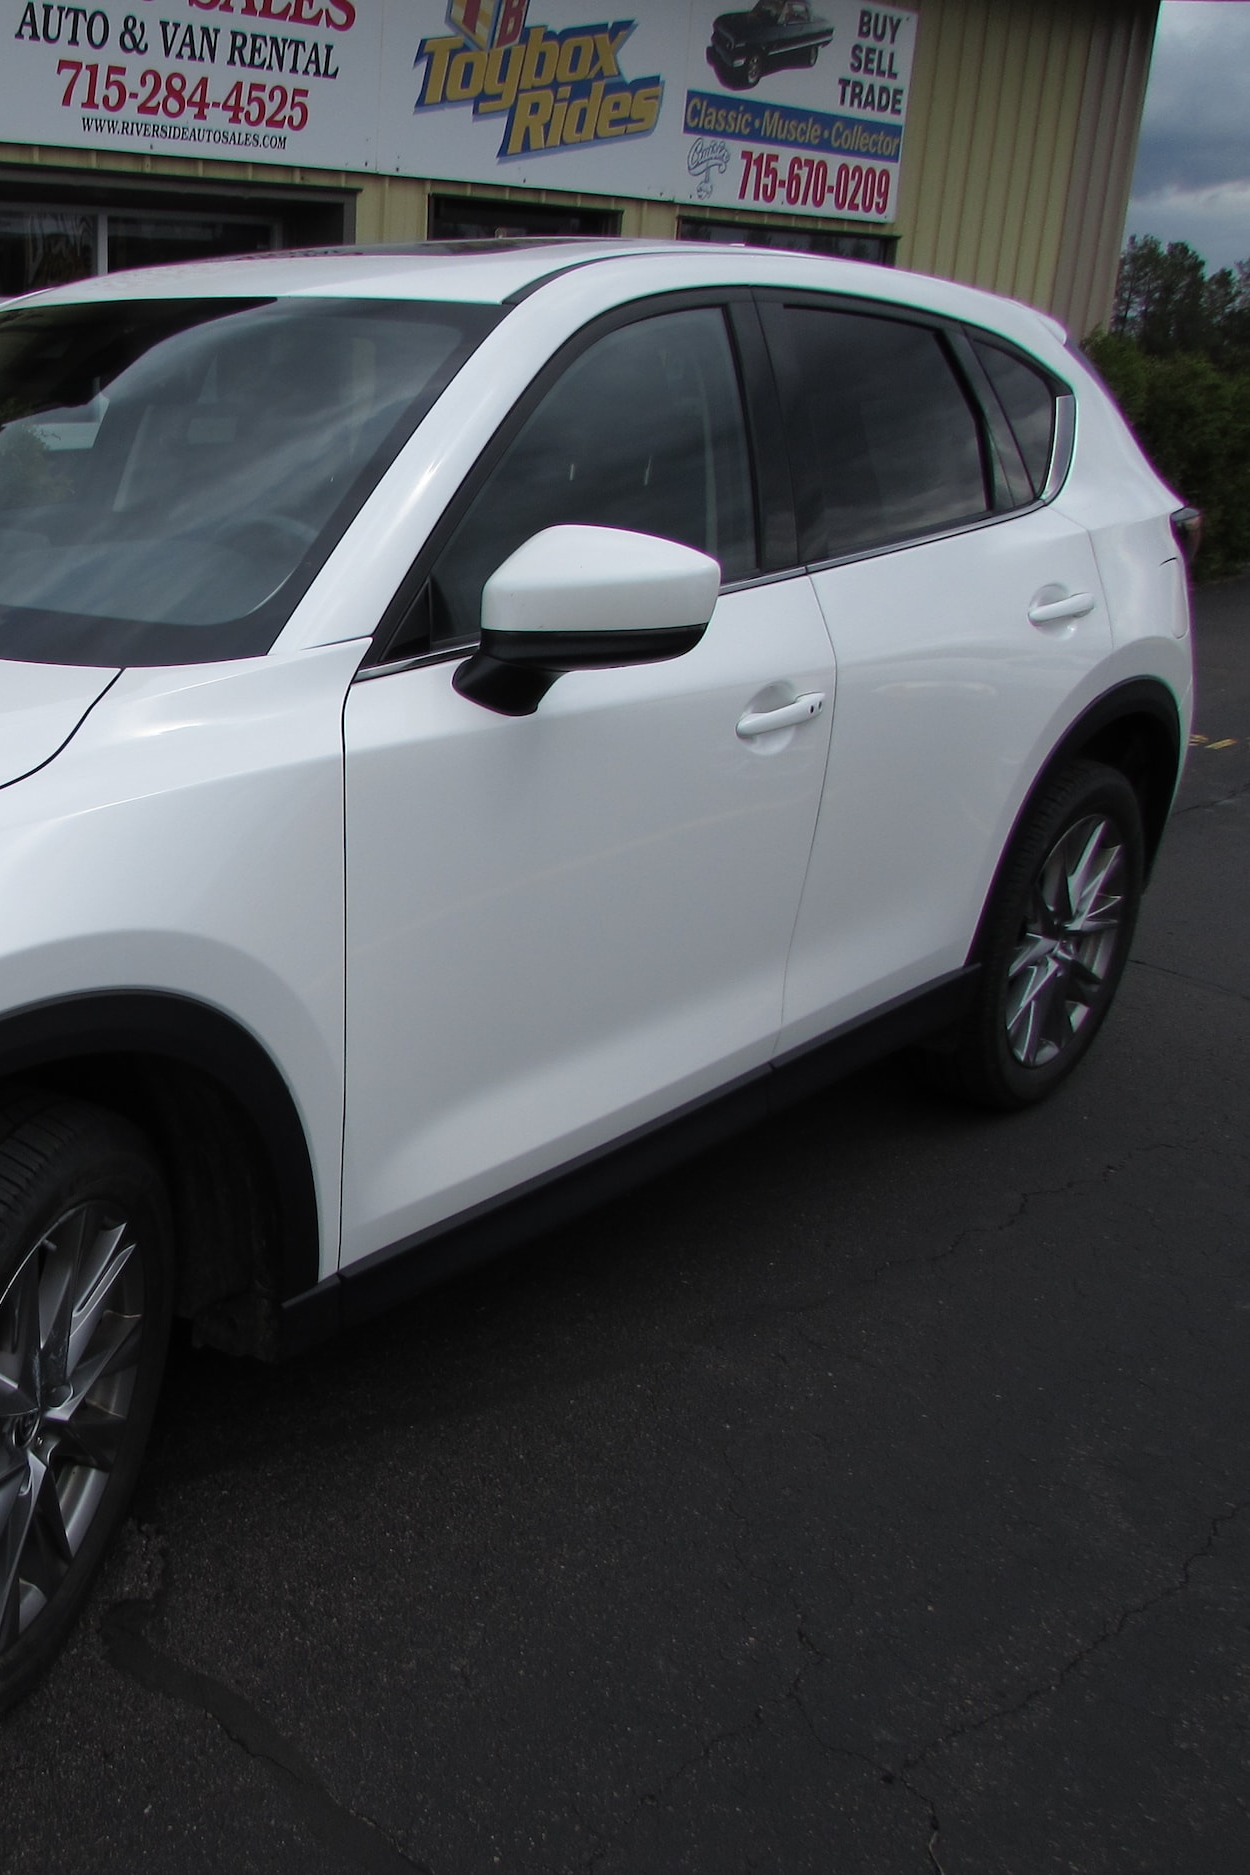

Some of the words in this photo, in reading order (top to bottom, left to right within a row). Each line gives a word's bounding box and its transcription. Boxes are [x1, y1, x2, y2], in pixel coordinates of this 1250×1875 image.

[15, 2, 110, 49] AUTO
[119, 15, 148, 56] &
[159, 20, 221, 65] VAN
[227, 30, 340, 80] RENTAL
[857, 9, 902, 45] BUY
[416, 23, 633, 115] Toybox
[850, 44, 898, 80] SELL
[56, 59, 310, 132] 715-284-4525
[504, 80, 664, 157] Rides
[685, 97, 752, 136] Classic
[760, 109, 821, 146] Muscle
[830, 120, 900, 157] Collector
[838, 78, 904, 116] TRADE
[81, 116, 288, 151] WWW.RIVERSIDEAUTOSALES.COM
[738, 150, 891, 216] 715-670-0209
